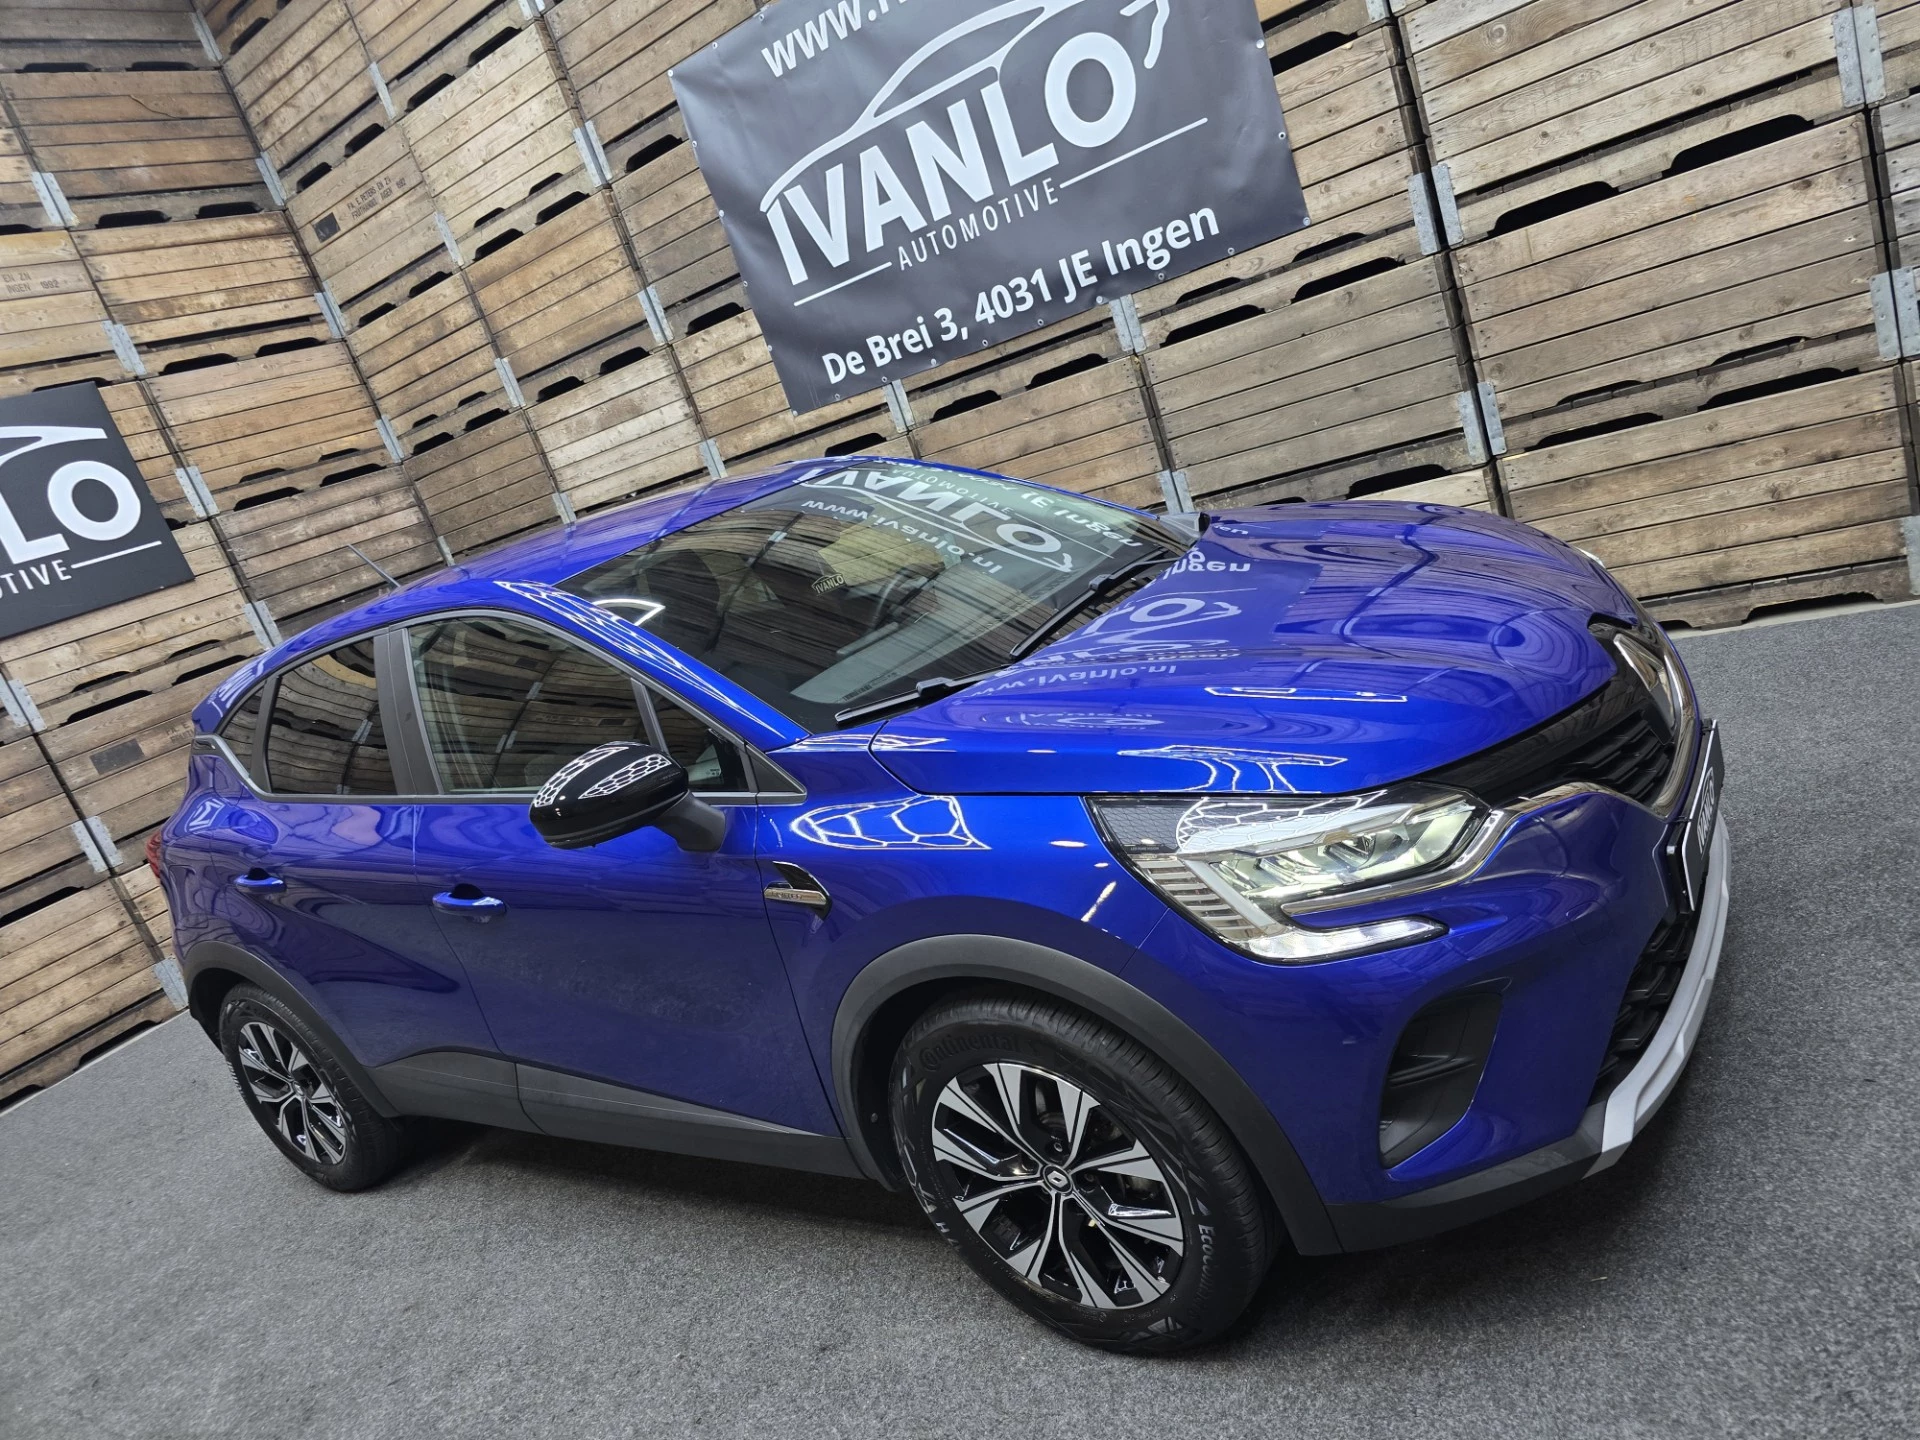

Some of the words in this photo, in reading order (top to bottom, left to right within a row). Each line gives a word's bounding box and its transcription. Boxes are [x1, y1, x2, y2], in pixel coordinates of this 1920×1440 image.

[766, 32, 1137, 285] IVANLO
[898, 177, 1059, 271] AUTOMOTIVE
[40, 279, 61, 289] 1992
[821, 351, 866, 385] De
[865, 315, 933, 369] Brei
[934, 307, 969, 341] 3,
[974, 268, 1053, 325] 4031
[1059, 249, 1097, 303] JE
[1101, 207, 1221, 271] Ingen
[0, 460, 141, 565] LO
[0, 559, 72, 599] TIVE
[815, 575, 844, 594] IVANLO
[919, 1032, 1019, 1072] Continental
